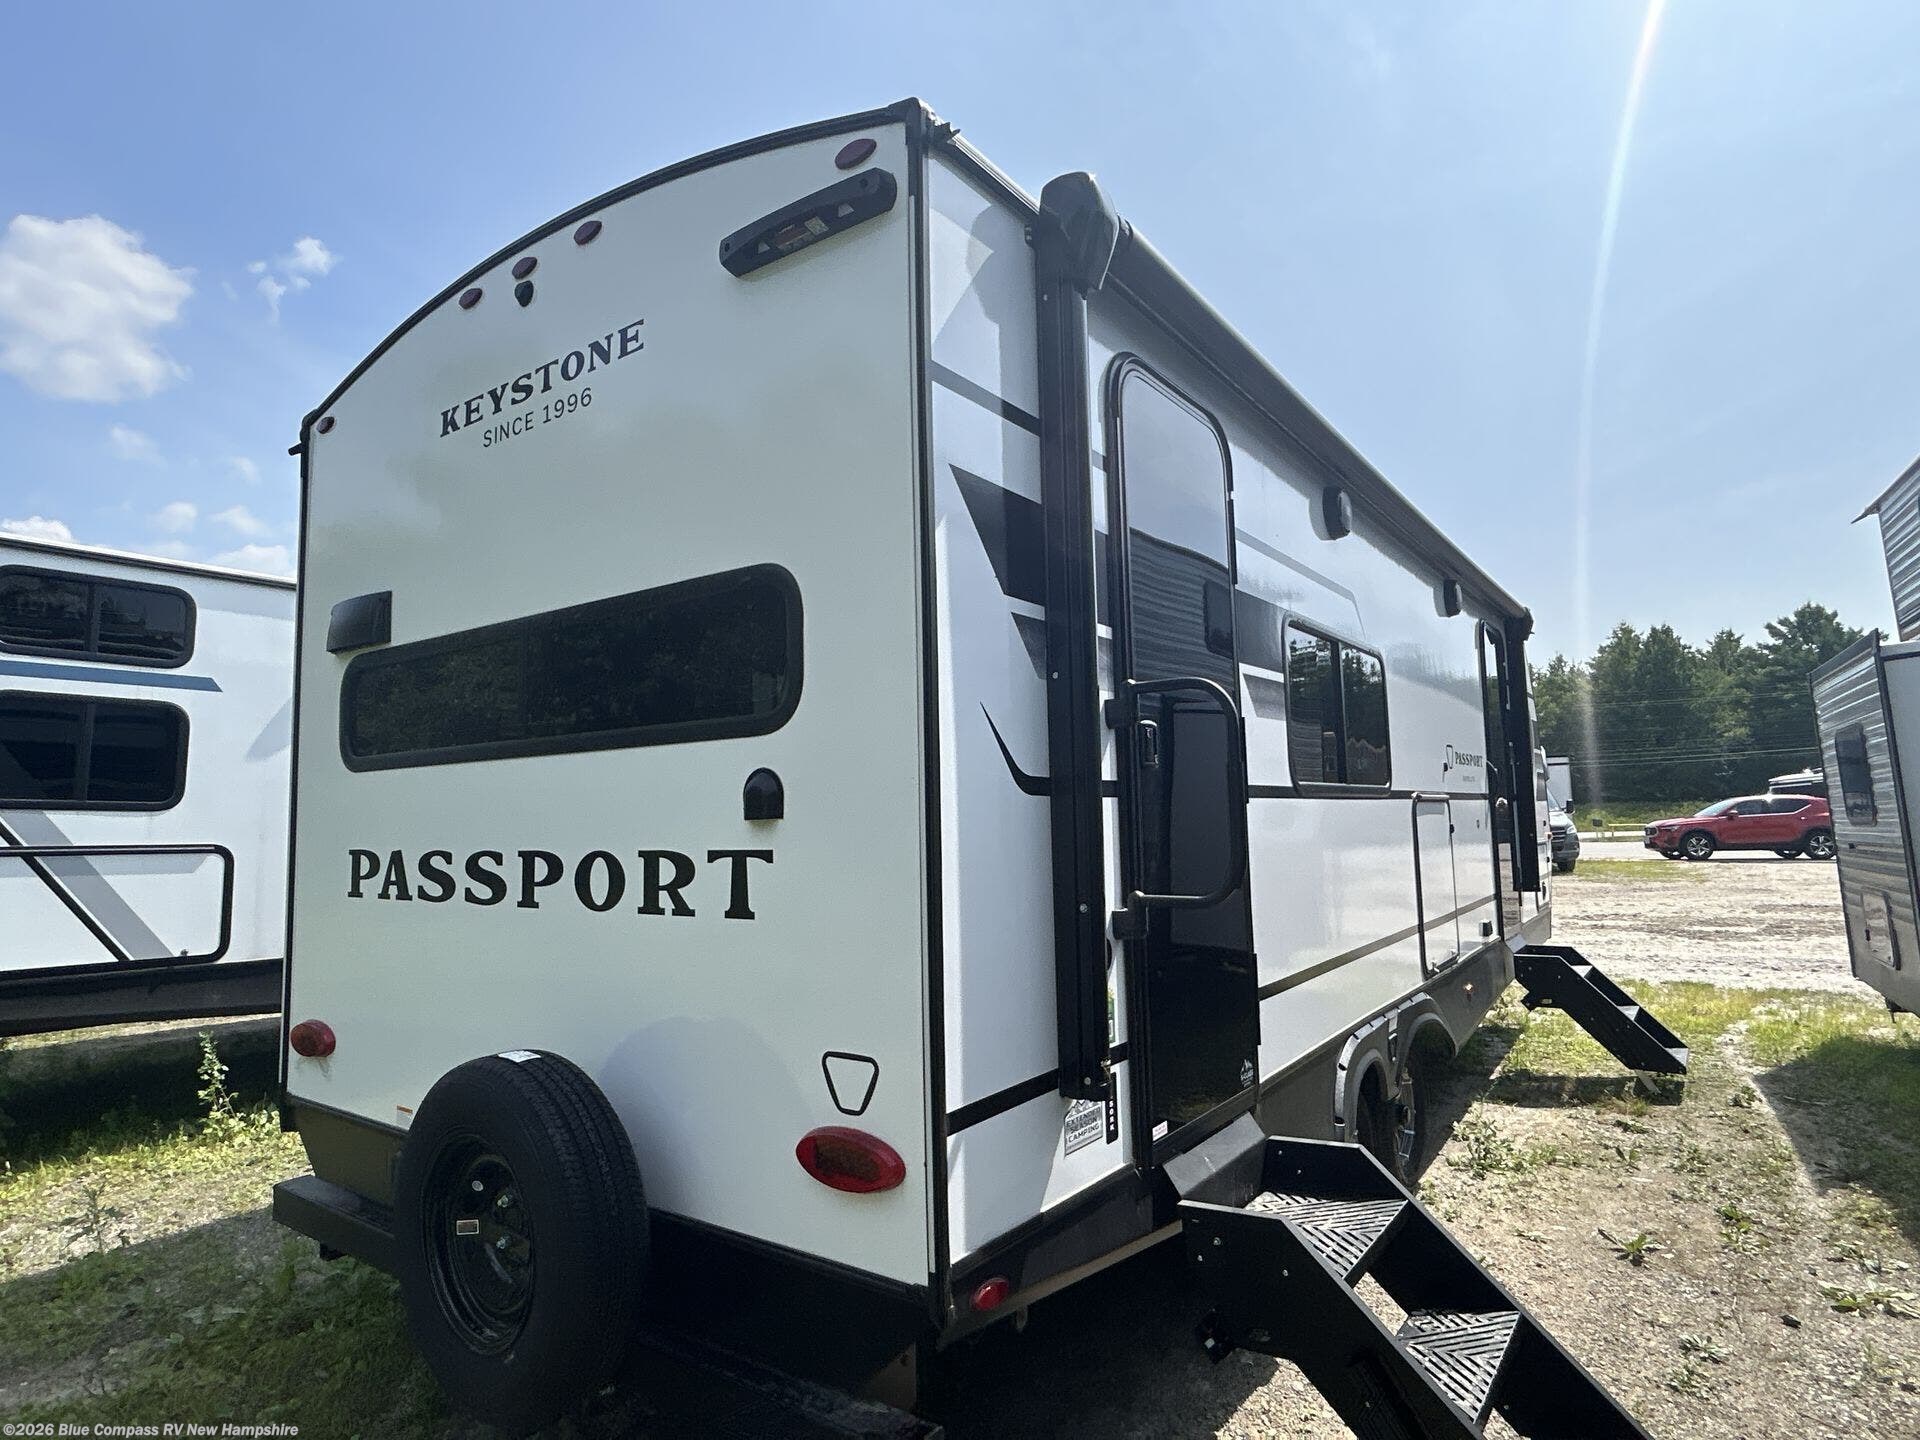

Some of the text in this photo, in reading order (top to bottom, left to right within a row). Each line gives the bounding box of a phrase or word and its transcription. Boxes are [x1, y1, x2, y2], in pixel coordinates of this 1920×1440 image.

[440, 318, 645, 438] KEYSTONE
[483, 387, 593, 448] SINCE 1996
[1455, 751, 1483, 768] PASSPORT
[347, 848, 774, 920] PASSPORT
[1068, 1122, 1100, 1143] CAMPING
